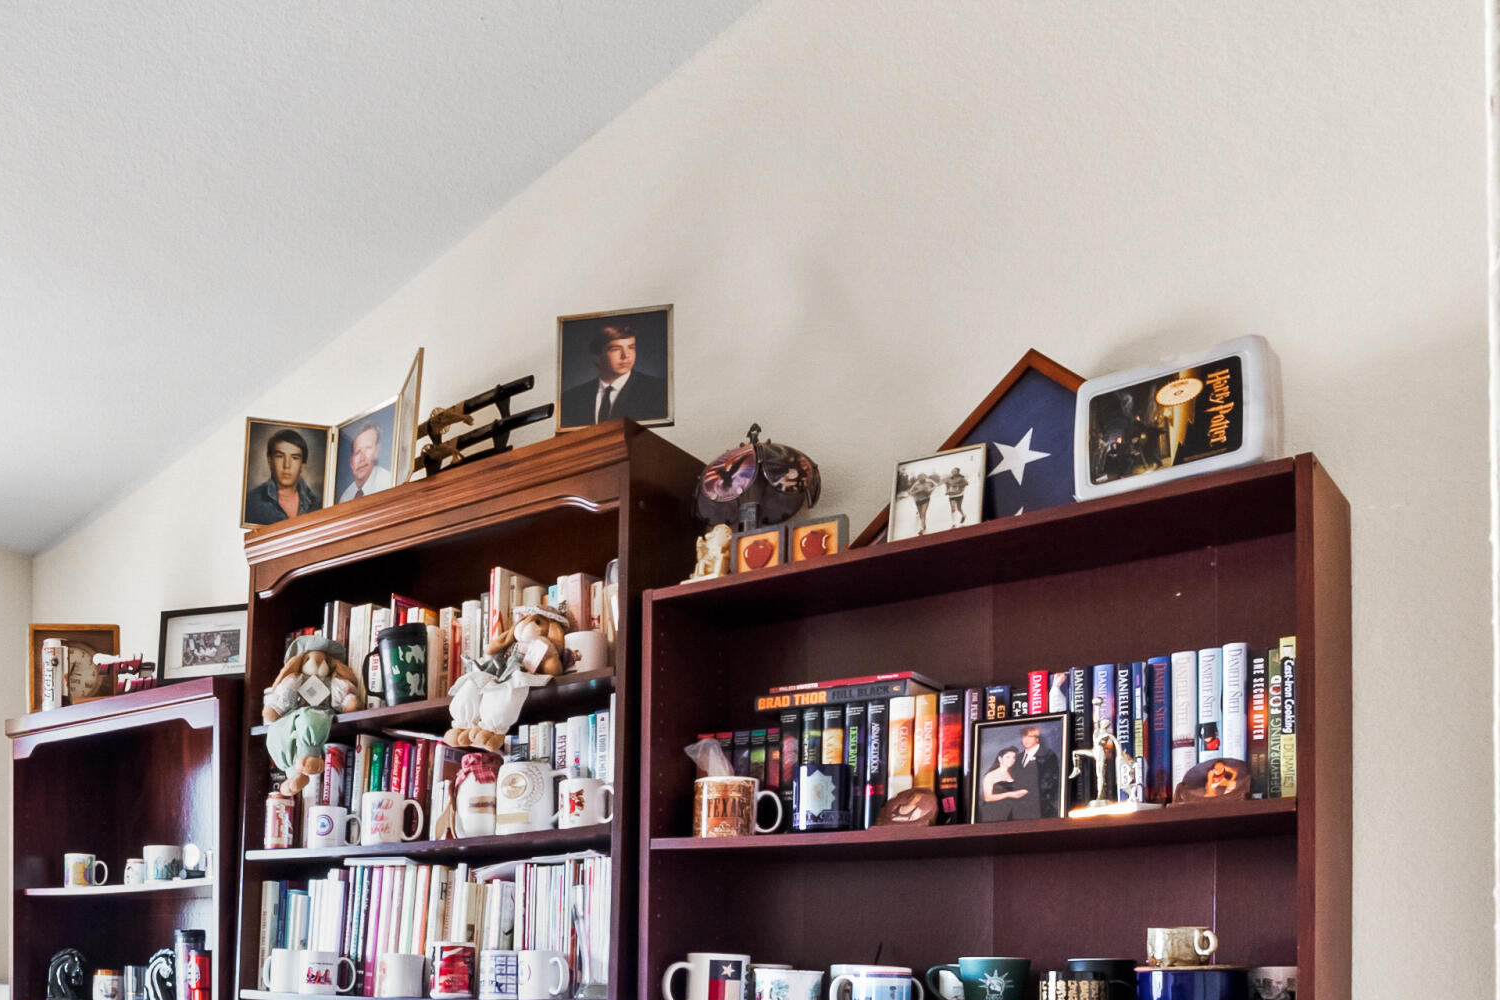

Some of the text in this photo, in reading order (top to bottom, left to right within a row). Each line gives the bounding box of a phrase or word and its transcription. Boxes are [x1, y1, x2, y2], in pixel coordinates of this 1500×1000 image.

[1204, 368, 1235, 448] Harry Potter
[757, 685, 890, 710] BRAD THOR FULL BLACK
[1118, 669, 1129, 714] DANIELLE
[1153, 662, 1167, 732] DANIELLE STEEL
[1177, 655, 1190, 728] DANIELLE STEEL
[1202, 654, 1216, 718] DANIELLE STEEL
[1227, 648, 1243, 714] DANIELLE STEEL
[1253, 657, 1265, 675] ONE
[1253, 677, 1265, 711] SECOND
[1281, 659, 1295, 734] Cast-Iron Cooking
[1073, 670, 1084, 743] DANIELLE STEEL
[1253, 713, 1265, 741] AFTER
[1269, 674, 1282, 793] DEHYDRATING FOOD
[871, 722, 881, 774] ARMAGEDDON
[923, 720, 933, 765] KINGDOM
